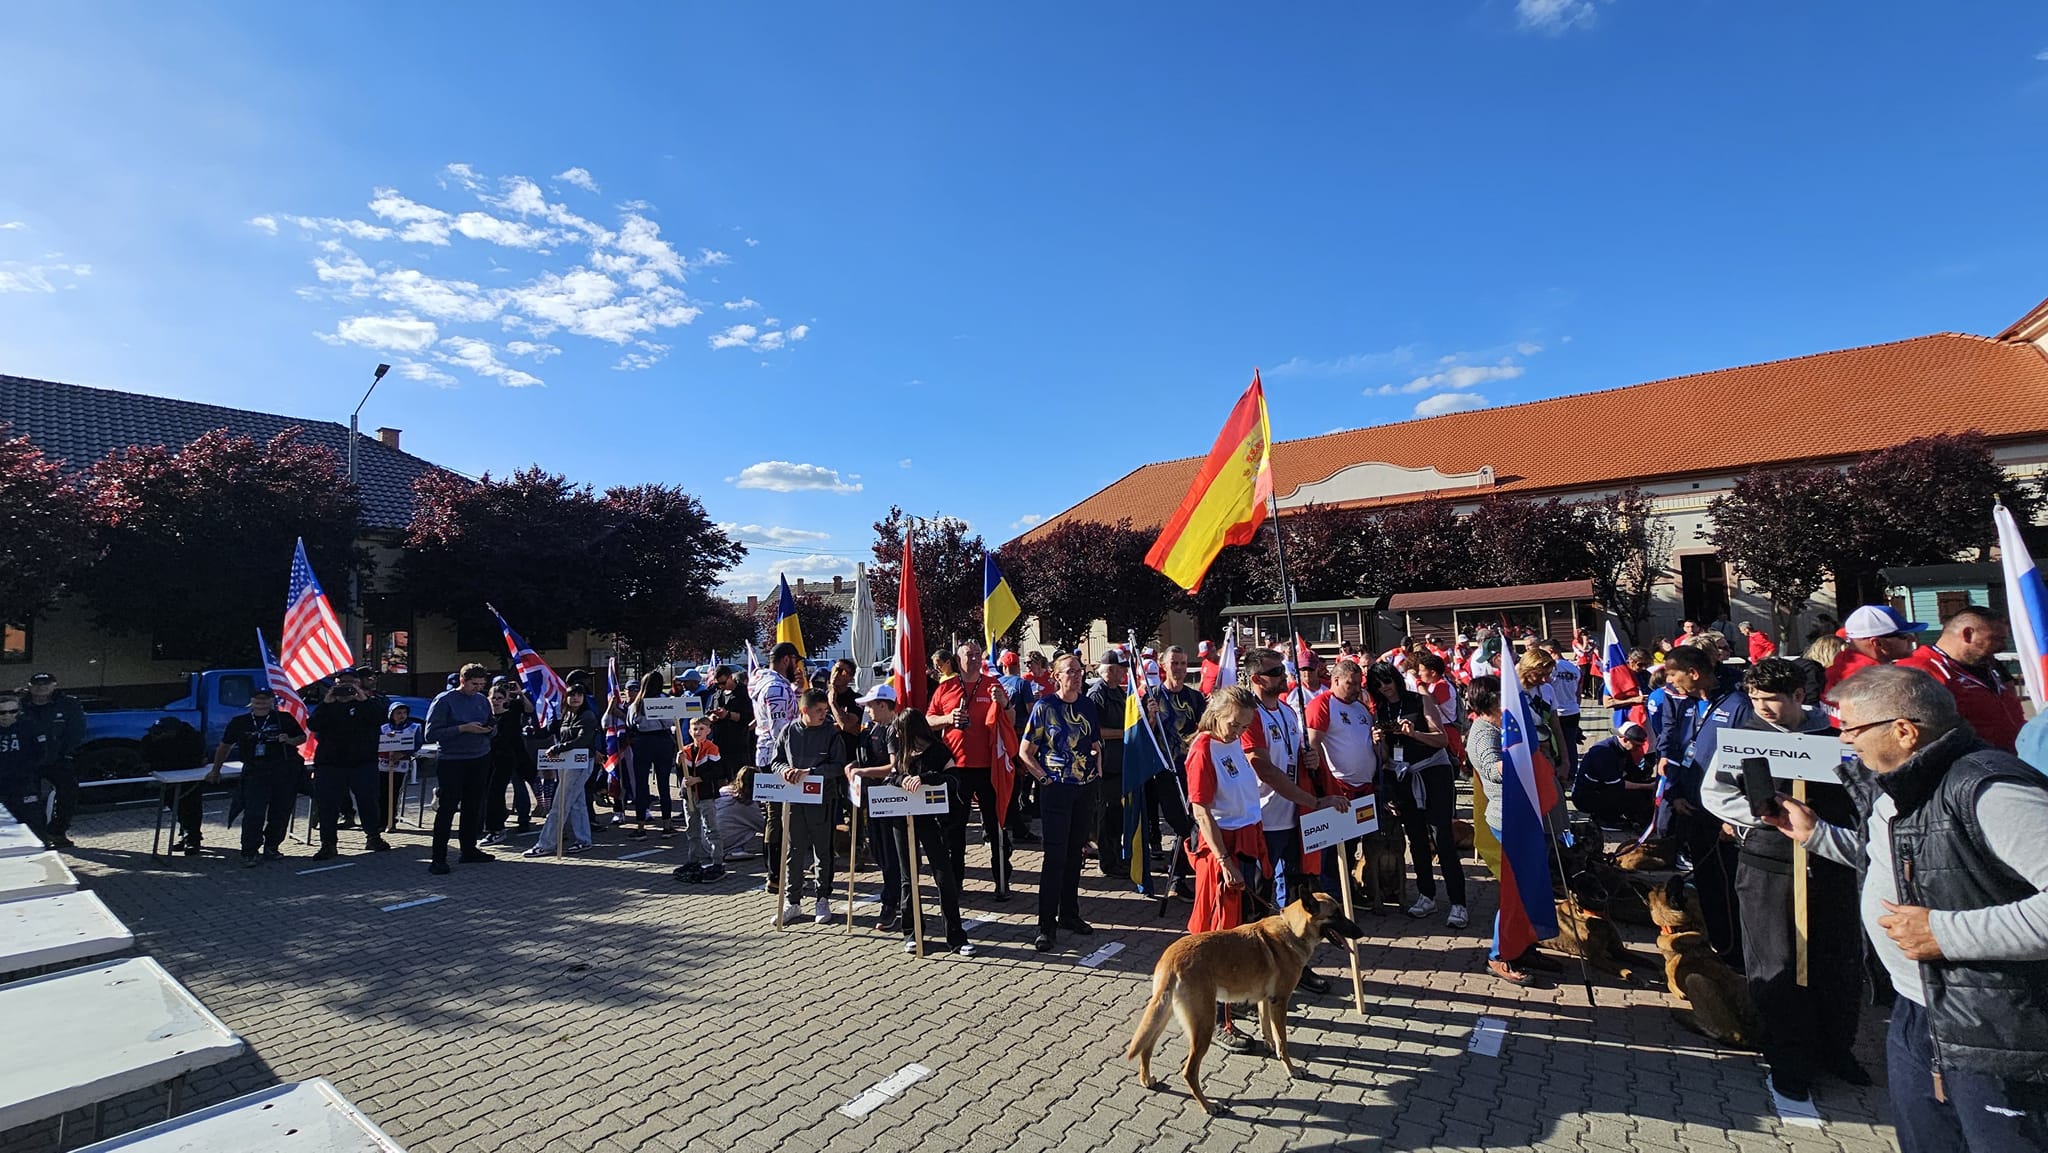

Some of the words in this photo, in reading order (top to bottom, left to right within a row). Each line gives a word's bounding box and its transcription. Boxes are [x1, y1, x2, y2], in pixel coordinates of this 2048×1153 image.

[1722, 745, 1812, 760] SLOVENIA
[871, 796, 908, 804] SWEDEN
[1303, 822, 1330, 837] SPAIN
